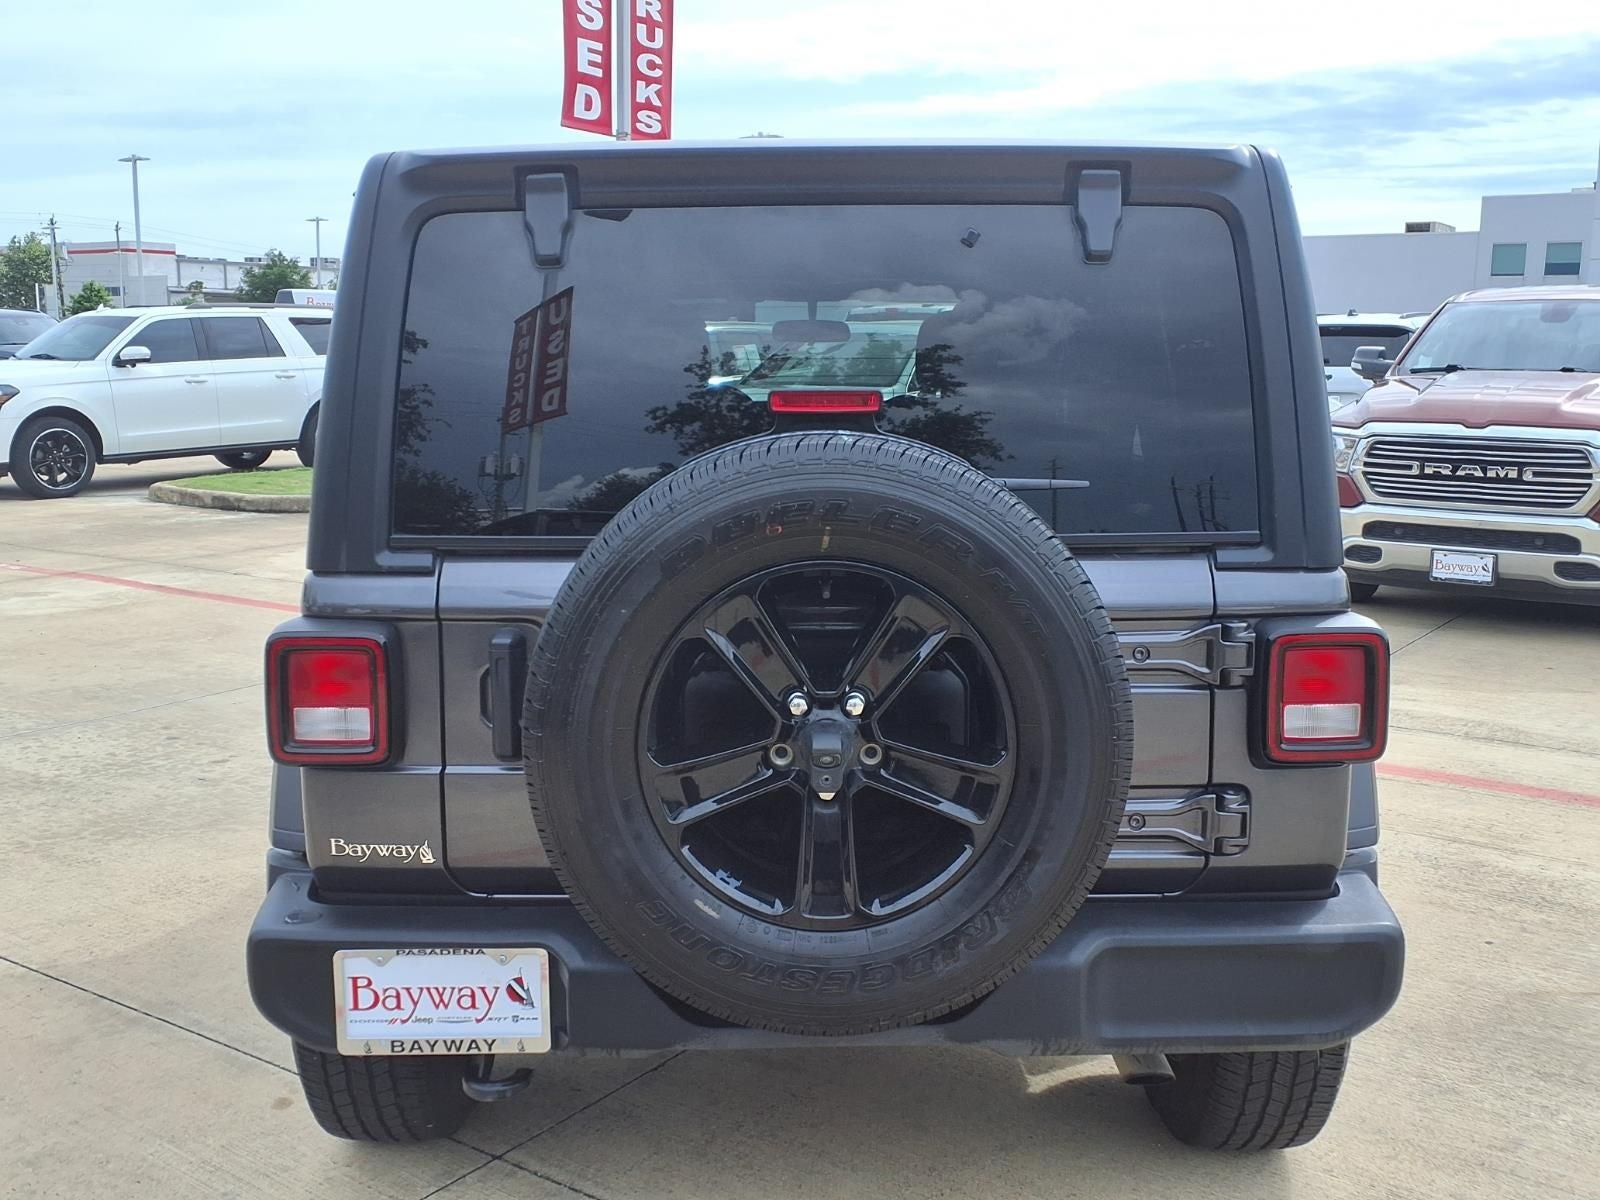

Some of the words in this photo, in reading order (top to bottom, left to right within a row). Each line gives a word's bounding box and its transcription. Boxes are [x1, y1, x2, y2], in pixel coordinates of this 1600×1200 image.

[1424, 462, 1518, 479] RAM
[1434, 559, 1480, 576] Bayway
[329, 838, 420, 863] Bayway
[396, 948, 487, 956] PASADENA
[347, 976, 500, 1024] Bayway
[411, 1016, 433, 1024] Jeep
[390, 1039, 497, 1054] BAYWAY
